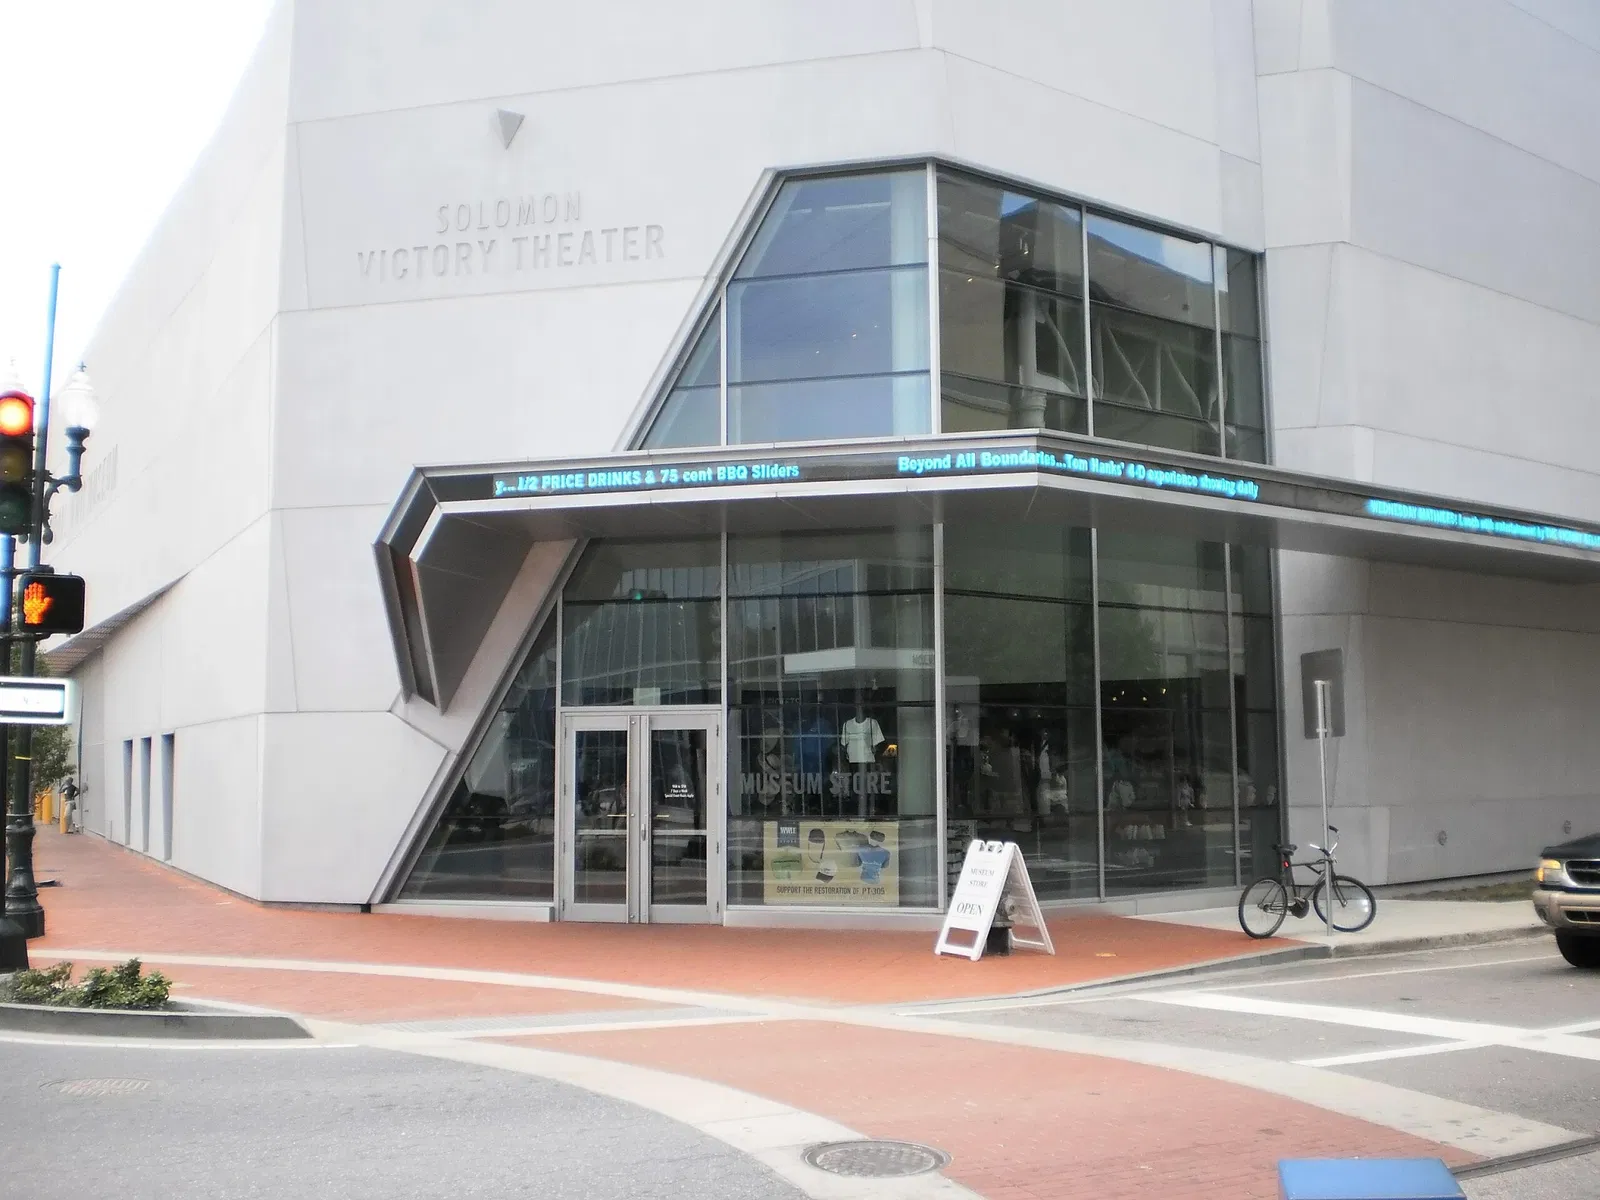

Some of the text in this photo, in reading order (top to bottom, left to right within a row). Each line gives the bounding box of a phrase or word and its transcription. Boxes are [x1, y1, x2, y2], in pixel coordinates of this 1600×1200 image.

[436, 191, 582, 235] SOLOMON
[357, 224, 666, 284] VICTORY THEATER
[898, 454, 952, 474] Beyond
[955, 452, 976, 468] All
[542, 474, 585, 489] PRICE
[588, 470, 641, 486] DRINKS
[644, 469, 656, 484] &
[660, 469, 679, 483] 75
[682, 466, 713, 482] cent
[716, 465, 748, 480] BBQ
[751, 463, 800, 479] Sliders
[740, 772, 891, 795] MUSEUM STORE
[970, 868, 994, 876] MUSEUM
[777, 886, 801, 895] SUPPORT
[803, 886, 813, 895] THE
[814, 886, 851, 895] RESTORATION
[853, 887, 859, 895] OF
[957, 902, 982, 916] OPEN
